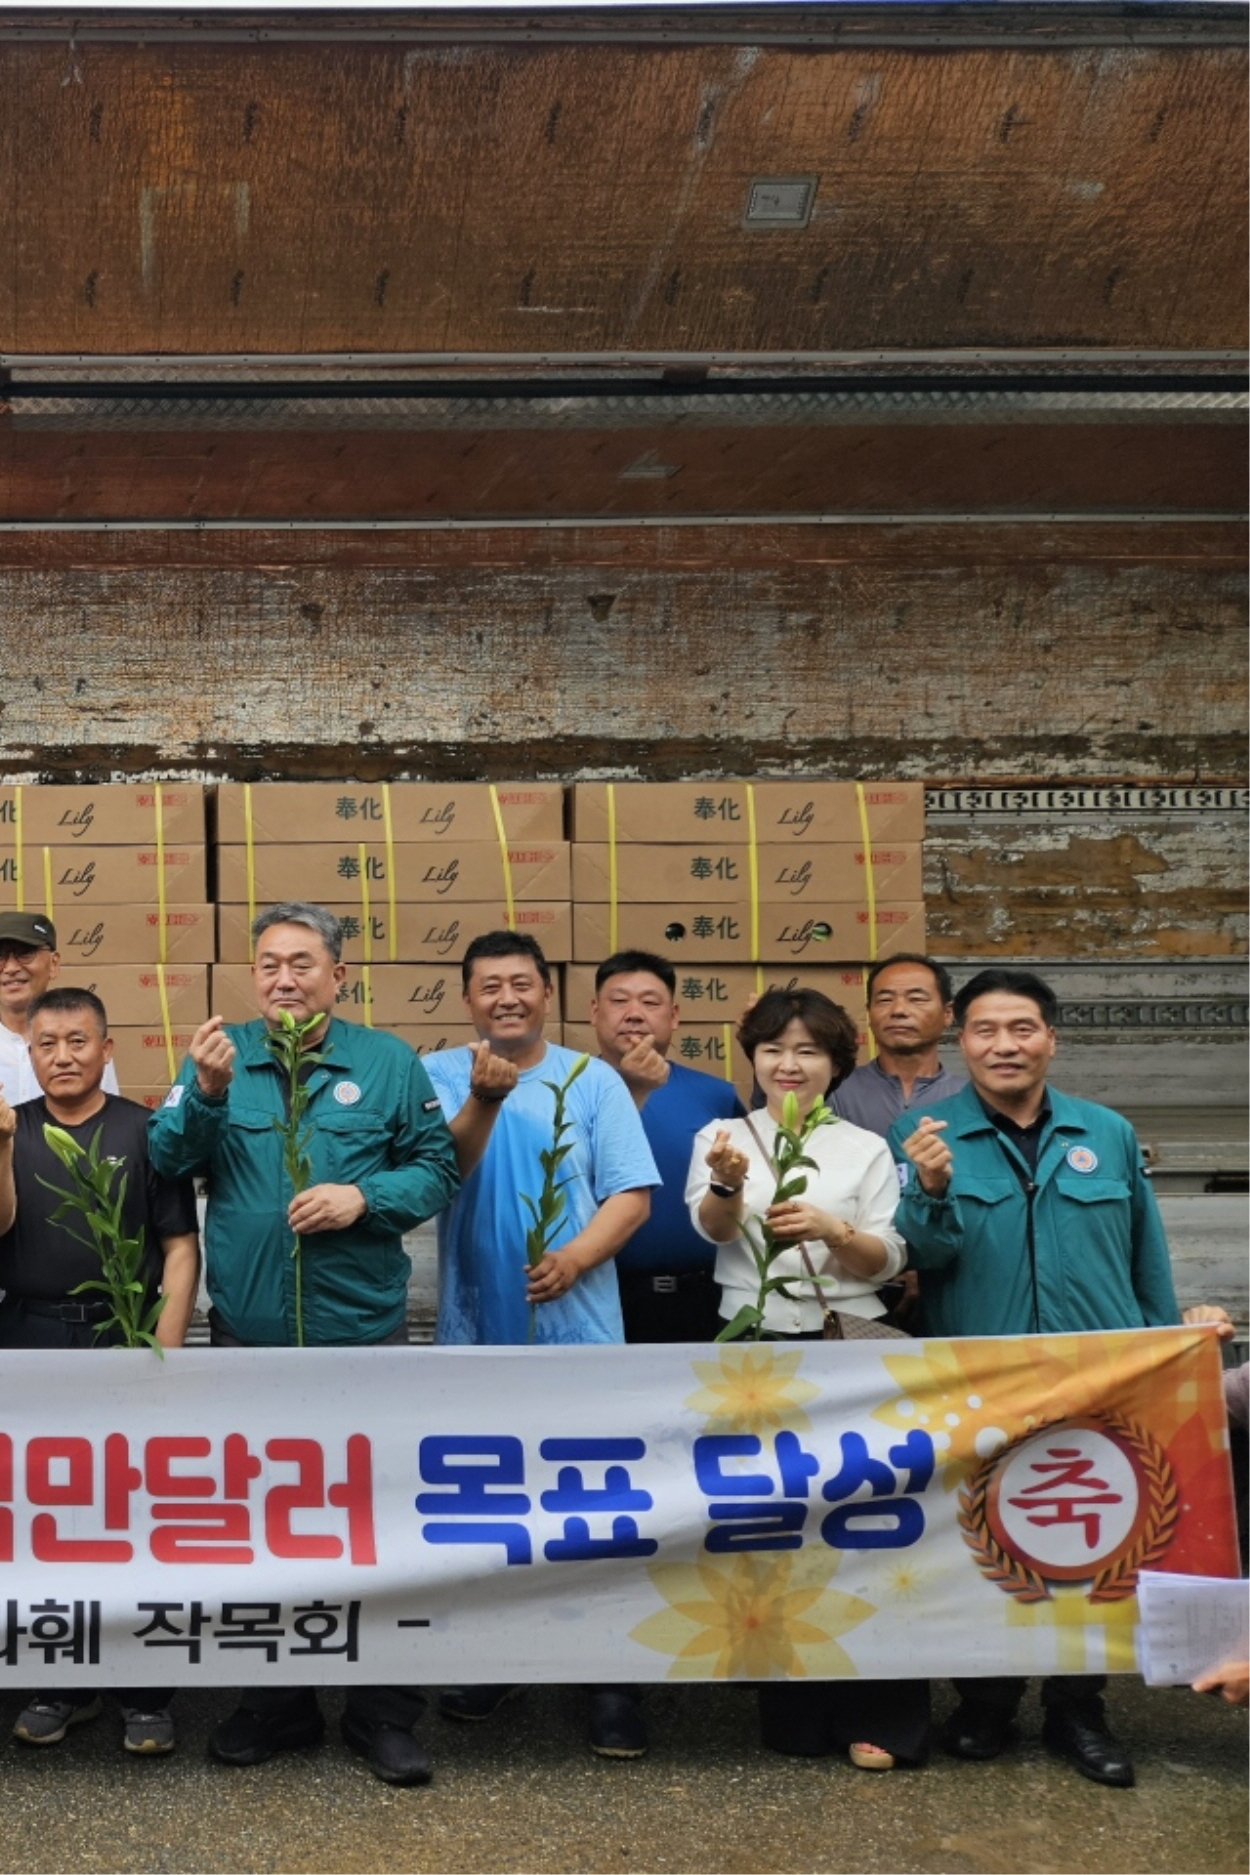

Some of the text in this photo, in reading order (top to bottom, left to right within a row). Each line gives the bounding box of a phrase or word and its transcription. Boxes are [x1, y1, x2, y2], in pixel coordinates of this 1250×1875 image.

[58, 803, 94, 838] Lily
[335, 796, 456, 835] 奉化 Lily
[693, 796, 814, 836] 奉化 Lily
[58, 862, 96, 897] Lily
[336, 856, 459, 894] 奉化 Lily
[691, 856, 812, 896] 奉化 Lily
[67, 922, 104, 958] Lily
[422, 920, 460, 955] Lily
[692, 915, 814, 954] 奉化 Lily
[408, 979, 446, 1014] Lily
[681, 977, 728, 1002] 奉化
[680, 1036, 726, 1061] 奉化
[415, 1434, 659, 1566] 목표
[692, 1429, 935, 1554] 달성
[1007, 1448, 1122, 1549] 축
[132, 1600, 362, 1664] 작목회
